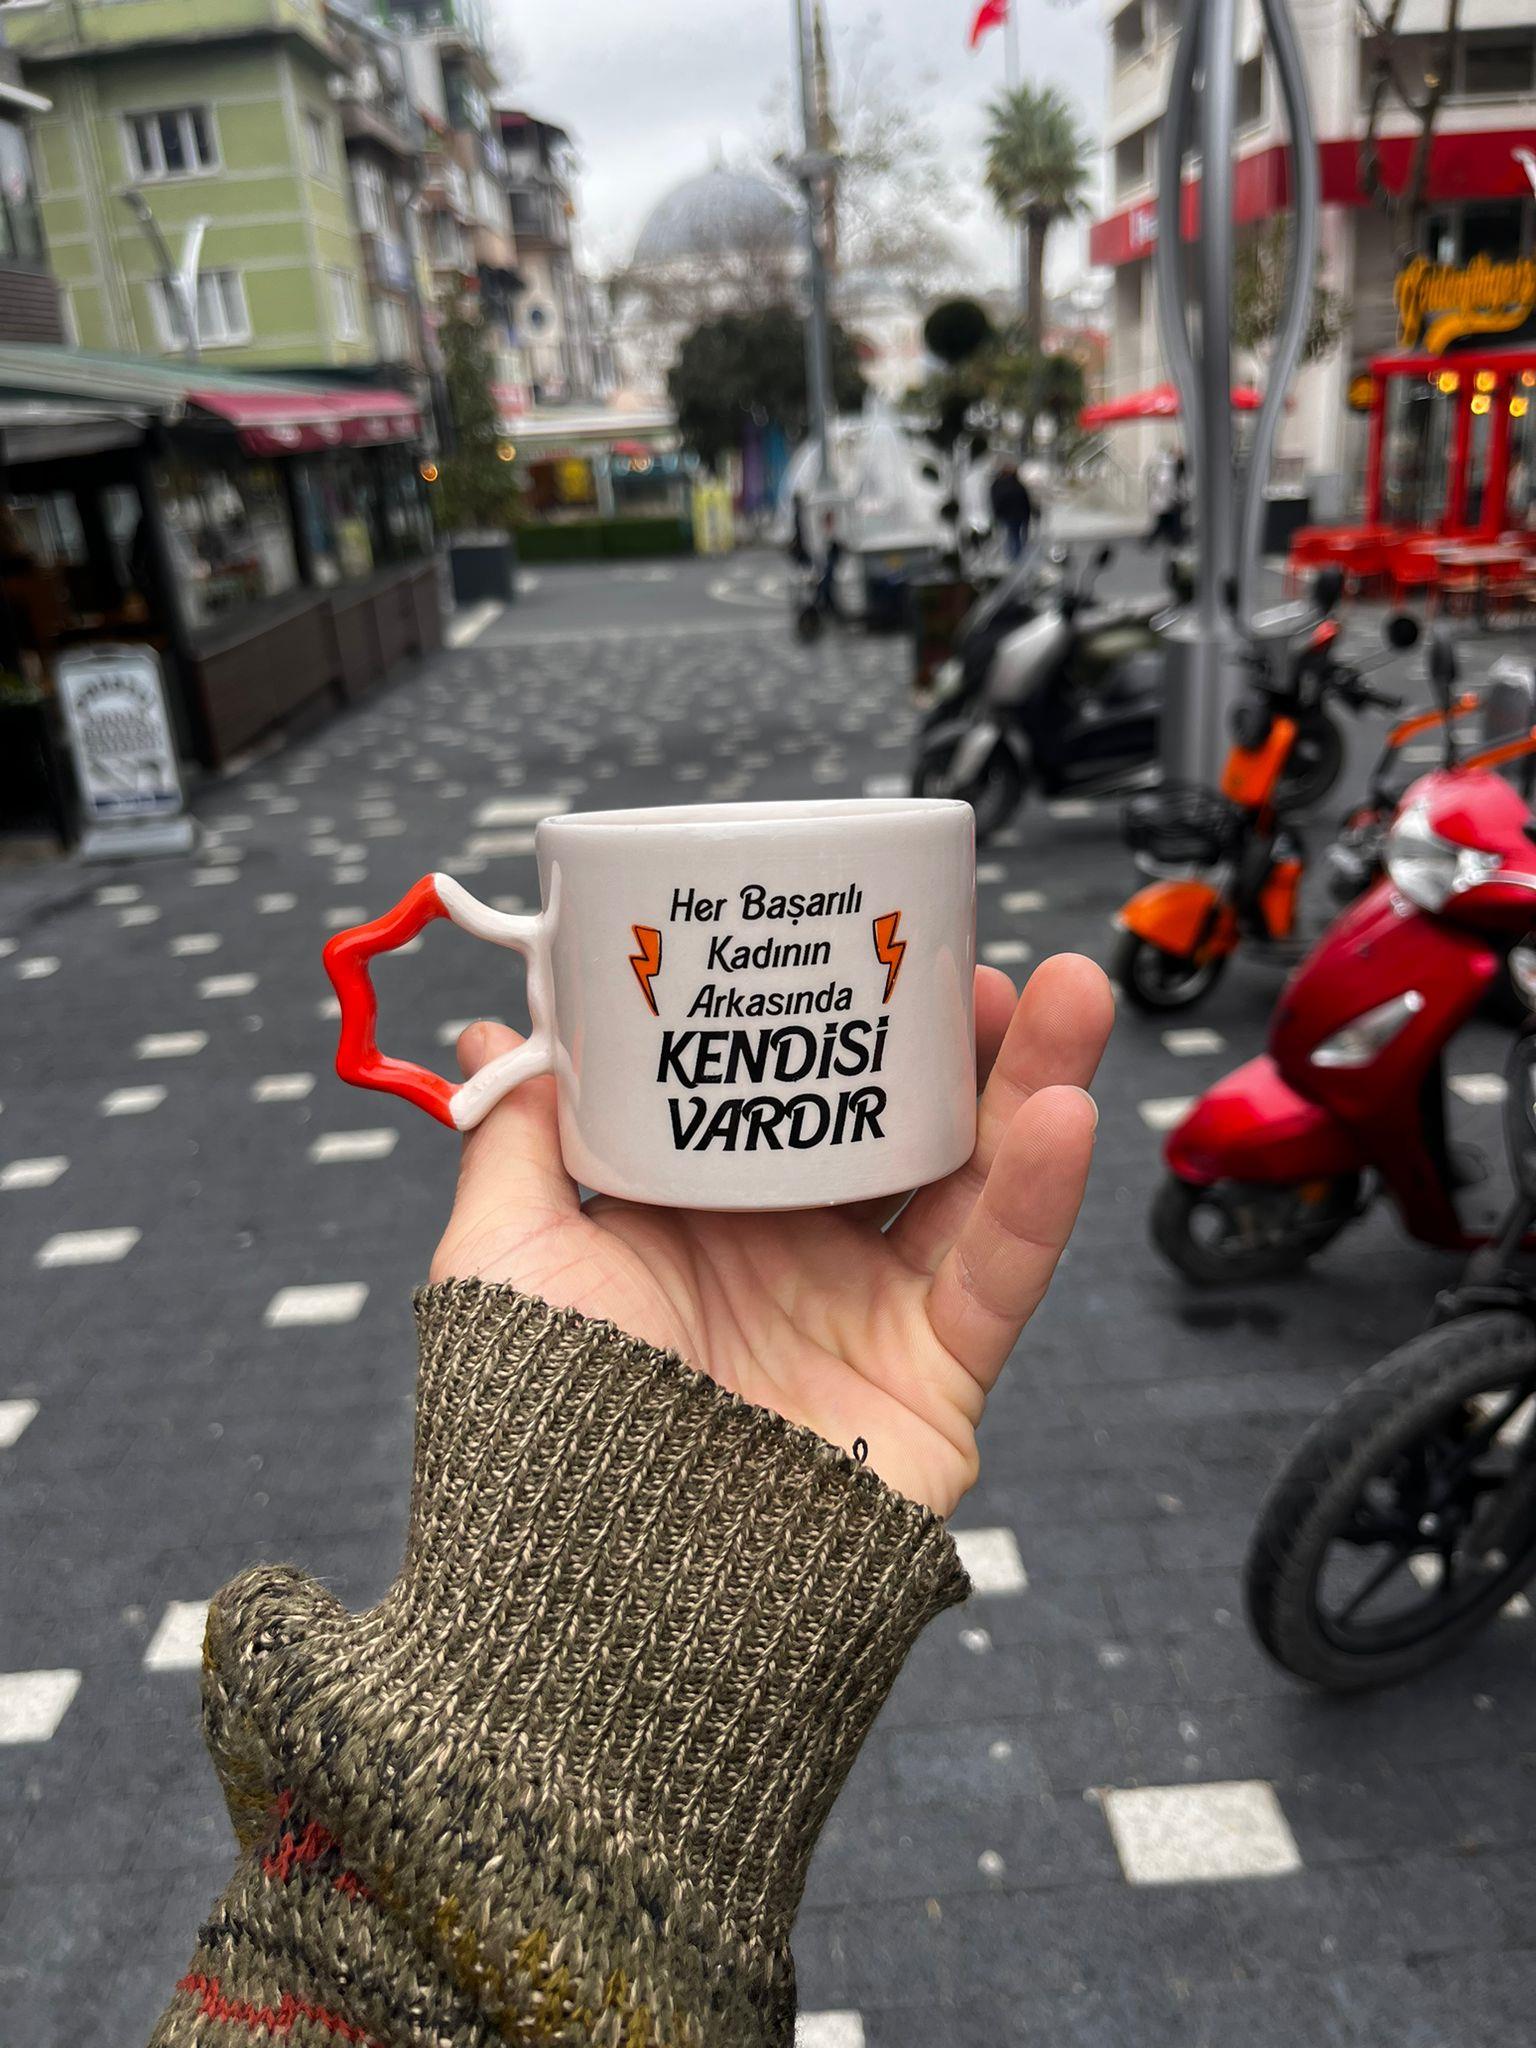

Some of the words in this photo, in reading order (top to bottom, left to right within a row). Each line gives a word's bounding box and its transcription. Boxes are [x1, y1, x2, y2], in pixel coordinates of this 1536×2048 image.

[669, 887, 728, 922] Her
[739, 883, 863, 926] Başarılı
[707, 935, 831, 973] Kadının
[686, 981, 853, 1018] Arkasında
[667, 1085, 887, 1152] VARDIR
